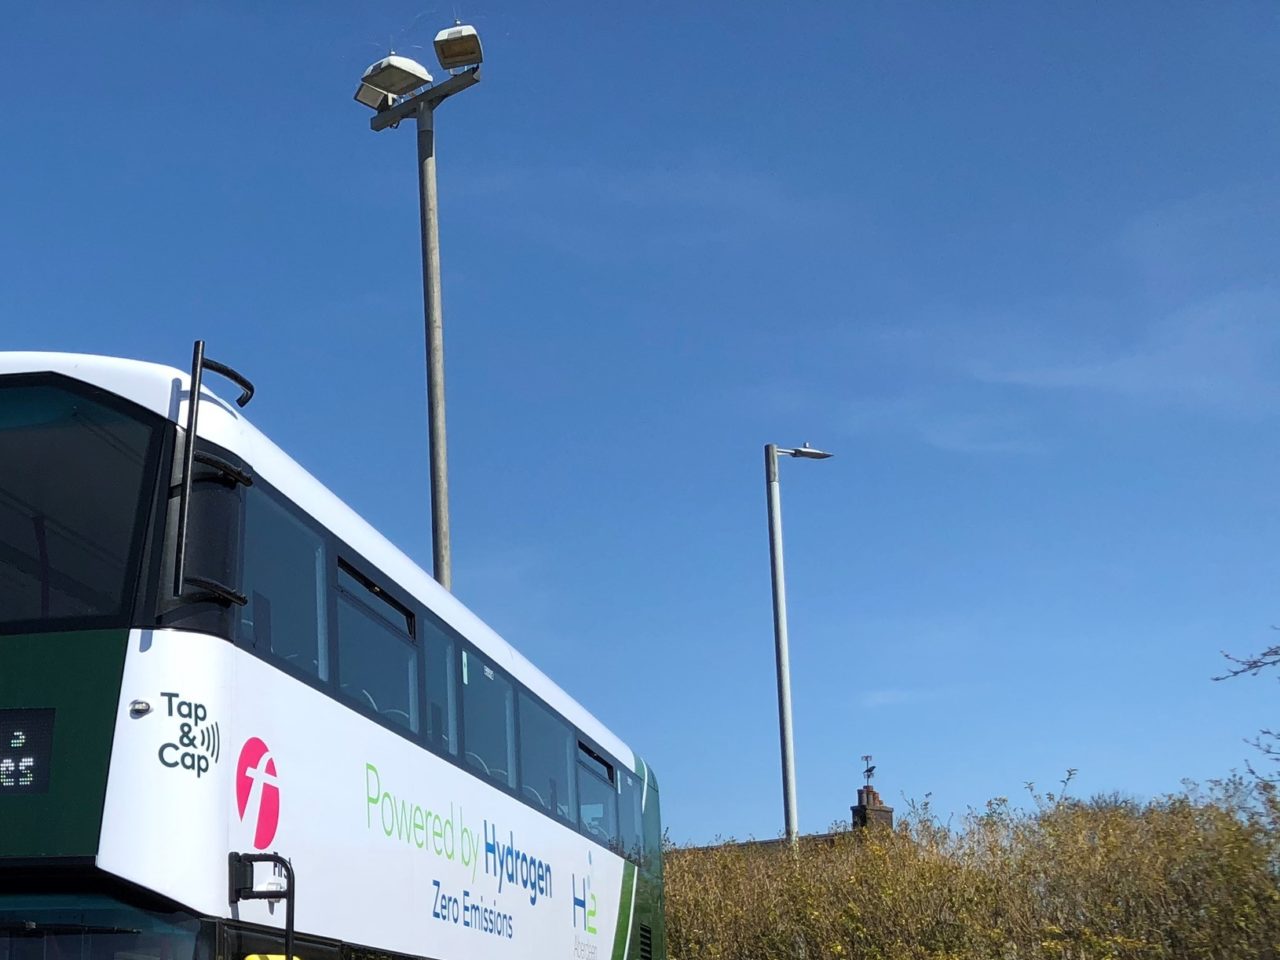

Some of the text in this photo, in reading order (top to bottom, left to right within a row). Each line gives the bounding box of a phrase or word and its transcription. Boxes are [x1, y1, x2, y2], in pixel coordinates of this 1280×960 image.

[160, 692, 207, 727] Tap
[179, 722, 198, 750] &
[158, 742, 210, 779] Cap
[365, 763, 553, 906] Powered by Hydrogen
[432, 879, 513, 939] Zero Emissions
